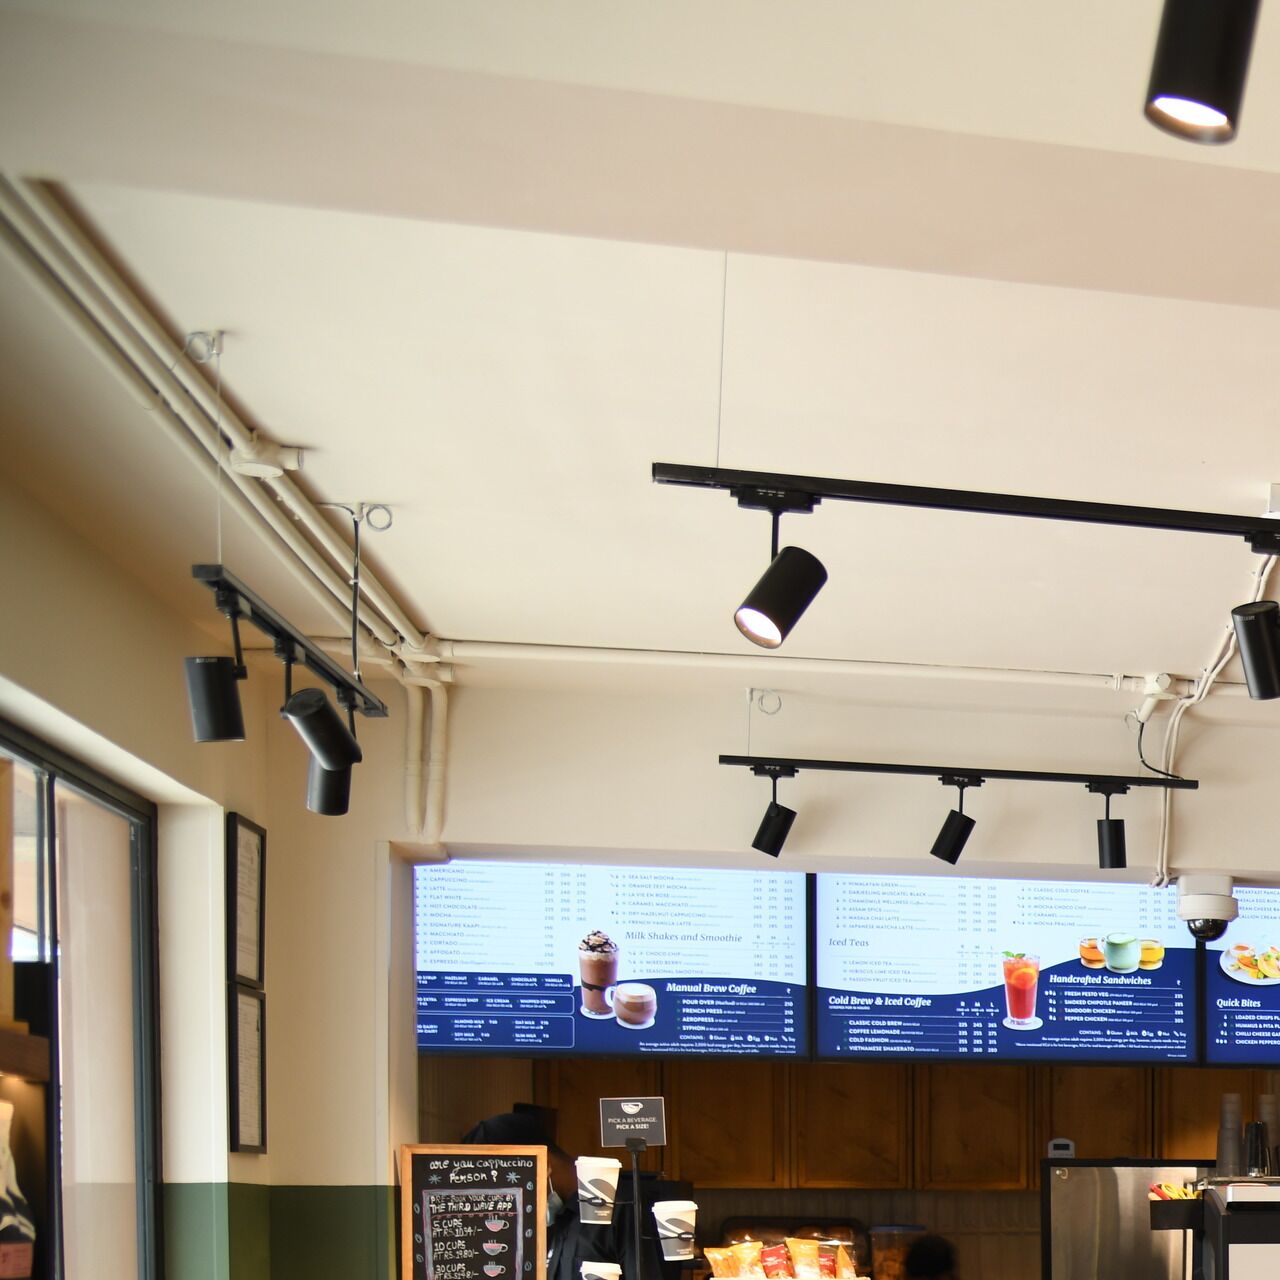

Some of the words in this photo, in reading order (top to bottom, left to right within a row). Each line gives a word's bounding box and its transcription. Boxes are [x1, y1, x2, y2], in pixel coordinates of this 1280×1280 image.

[625, 932, 646, 940] Milk
[649, 933, 679, 941] Shakes
[681, 933, 697, 941] and
[700, 934, 742, 942] Smoothie
[829, 938, 846, 946] Iced
[849, 939, 869, 947] Teas
[1050, 975, 1101, 986] Handcrafted
[1103, 976, 1151, 985] Sandwiches
[666, 983, 701, 992] Manual
[704, 983, 727, 992] Brew
[728, 984, 756, 995] Coffee
[829, 996, 849, 1005] Cold
[850, 996, 873, 1005] Brew
[875, 997, 882, 1005] &
[885, 997, 903, 1005] Iced
[904, 997, 931, 1008] Coffee
[1217, 999, 1239, 1008] Quick
[1242, 999, 1261, 1007] Bites
[430, 1160, 449, 1169] are
[452, 1160, 474, 1174] you
[476, 1159, 533, 1169] cappuccino
[449, 1173, 487, 1183] Person
[491, 1170, 498, 1182] ?
[430, 1204, 445, 1214] THE
[448, 1202, 471, 1212] THIRD
[473, 1202, 495, 1211] WAVE
[497, 1202, 512, 1211] APP
[433, 1220, 440, 1228] 5
[442, 1219, 462, 1228] CUPS
[434, 1242, 445, 1251] 10
[446, 1240, 466, 1250] CUPS
[436, 1265, 445, 1273] 30
[446, 1263, 466, 1272] CUPS
